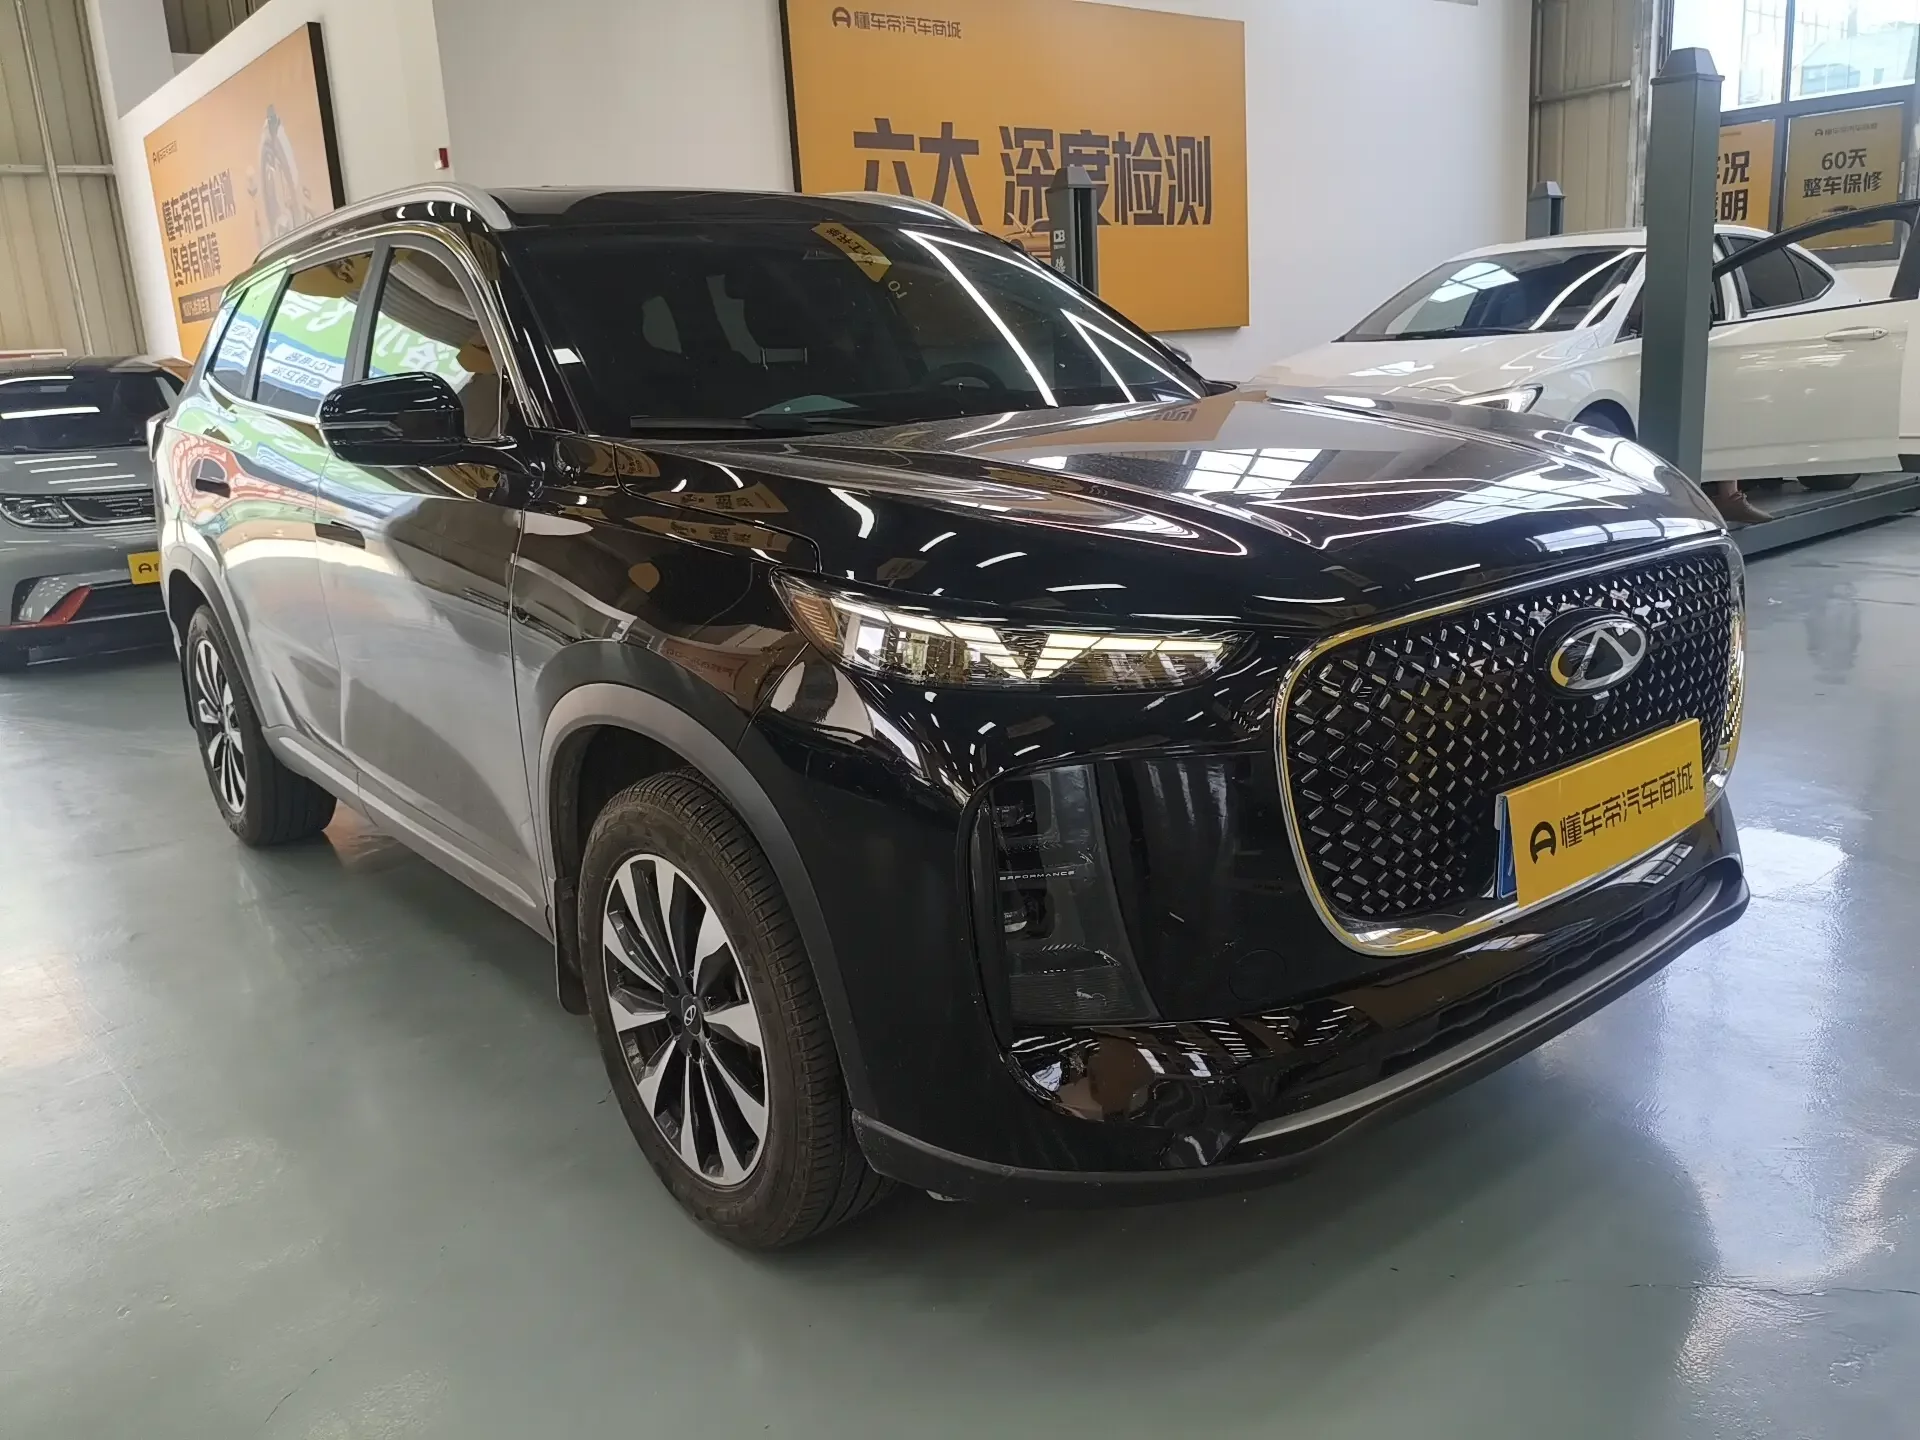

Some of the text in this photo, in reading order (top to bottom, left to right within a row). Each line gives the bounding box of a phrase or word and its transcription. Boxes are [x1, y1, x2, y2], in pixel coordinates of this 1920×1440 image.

[854, 11, 962, 39] 懂车帝汽车商城
[853, 117, 1212, 226] 六大 深度检测
[1715, 150, 1750, 185] 况
[1821, 148, 1867, 170] 60天
[1803, 171, 1883, 198] 整车保修
[1714, 189, 1749, 222] 明
[1560, 762, 1694, 849] 懂车帝汽车商城
